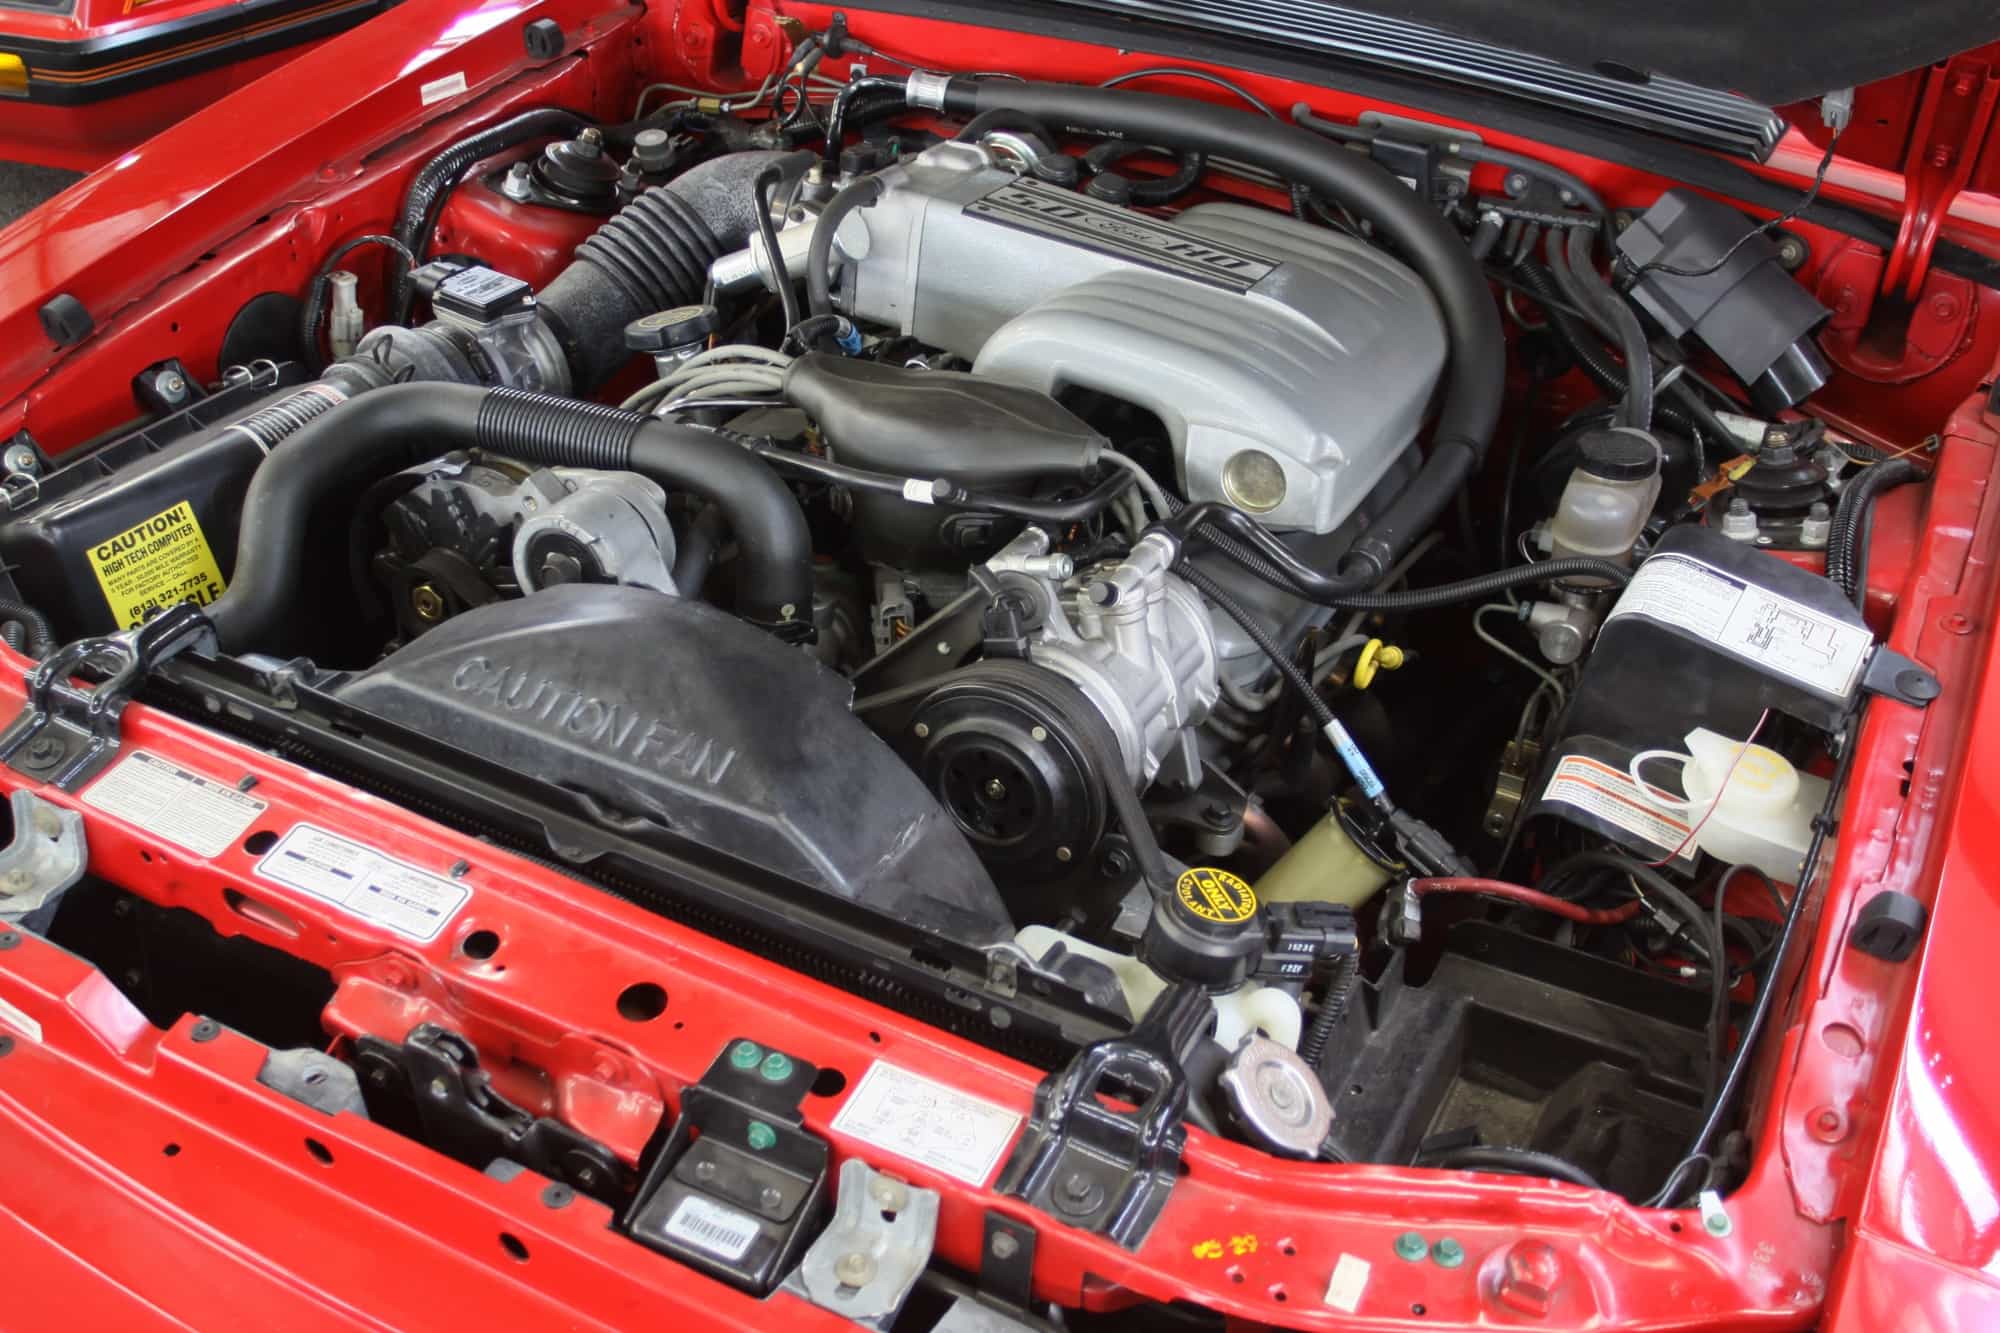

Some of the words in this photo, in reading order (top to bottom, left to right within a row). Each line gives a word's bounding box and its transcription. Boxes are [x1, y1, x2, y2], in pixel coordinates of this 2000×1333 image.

[1000, 193, 1084, 218] 5.0
[1100, 221, 1150, 241] Ford
[1164, 243, 1250, 269] HO
[97, 507, 186, 562] CAUTION!
[103, 559, 125, 577] HIGH
[125, 547, 148, 566] TECH
[147, 523, 194, 555] COMPUTER
[130, 598, 158, 618] (813)
[160, 572, 208, 603] 321-7735
[453, 655, 640, 750] CAUTION
[631, 718, 737, 785] FAN
[1181, 878, 1216, 918] COOLANT
[1201, 879, 1233, 912] ONLY
[1218, 872, 1252, 914] RADIATOR
